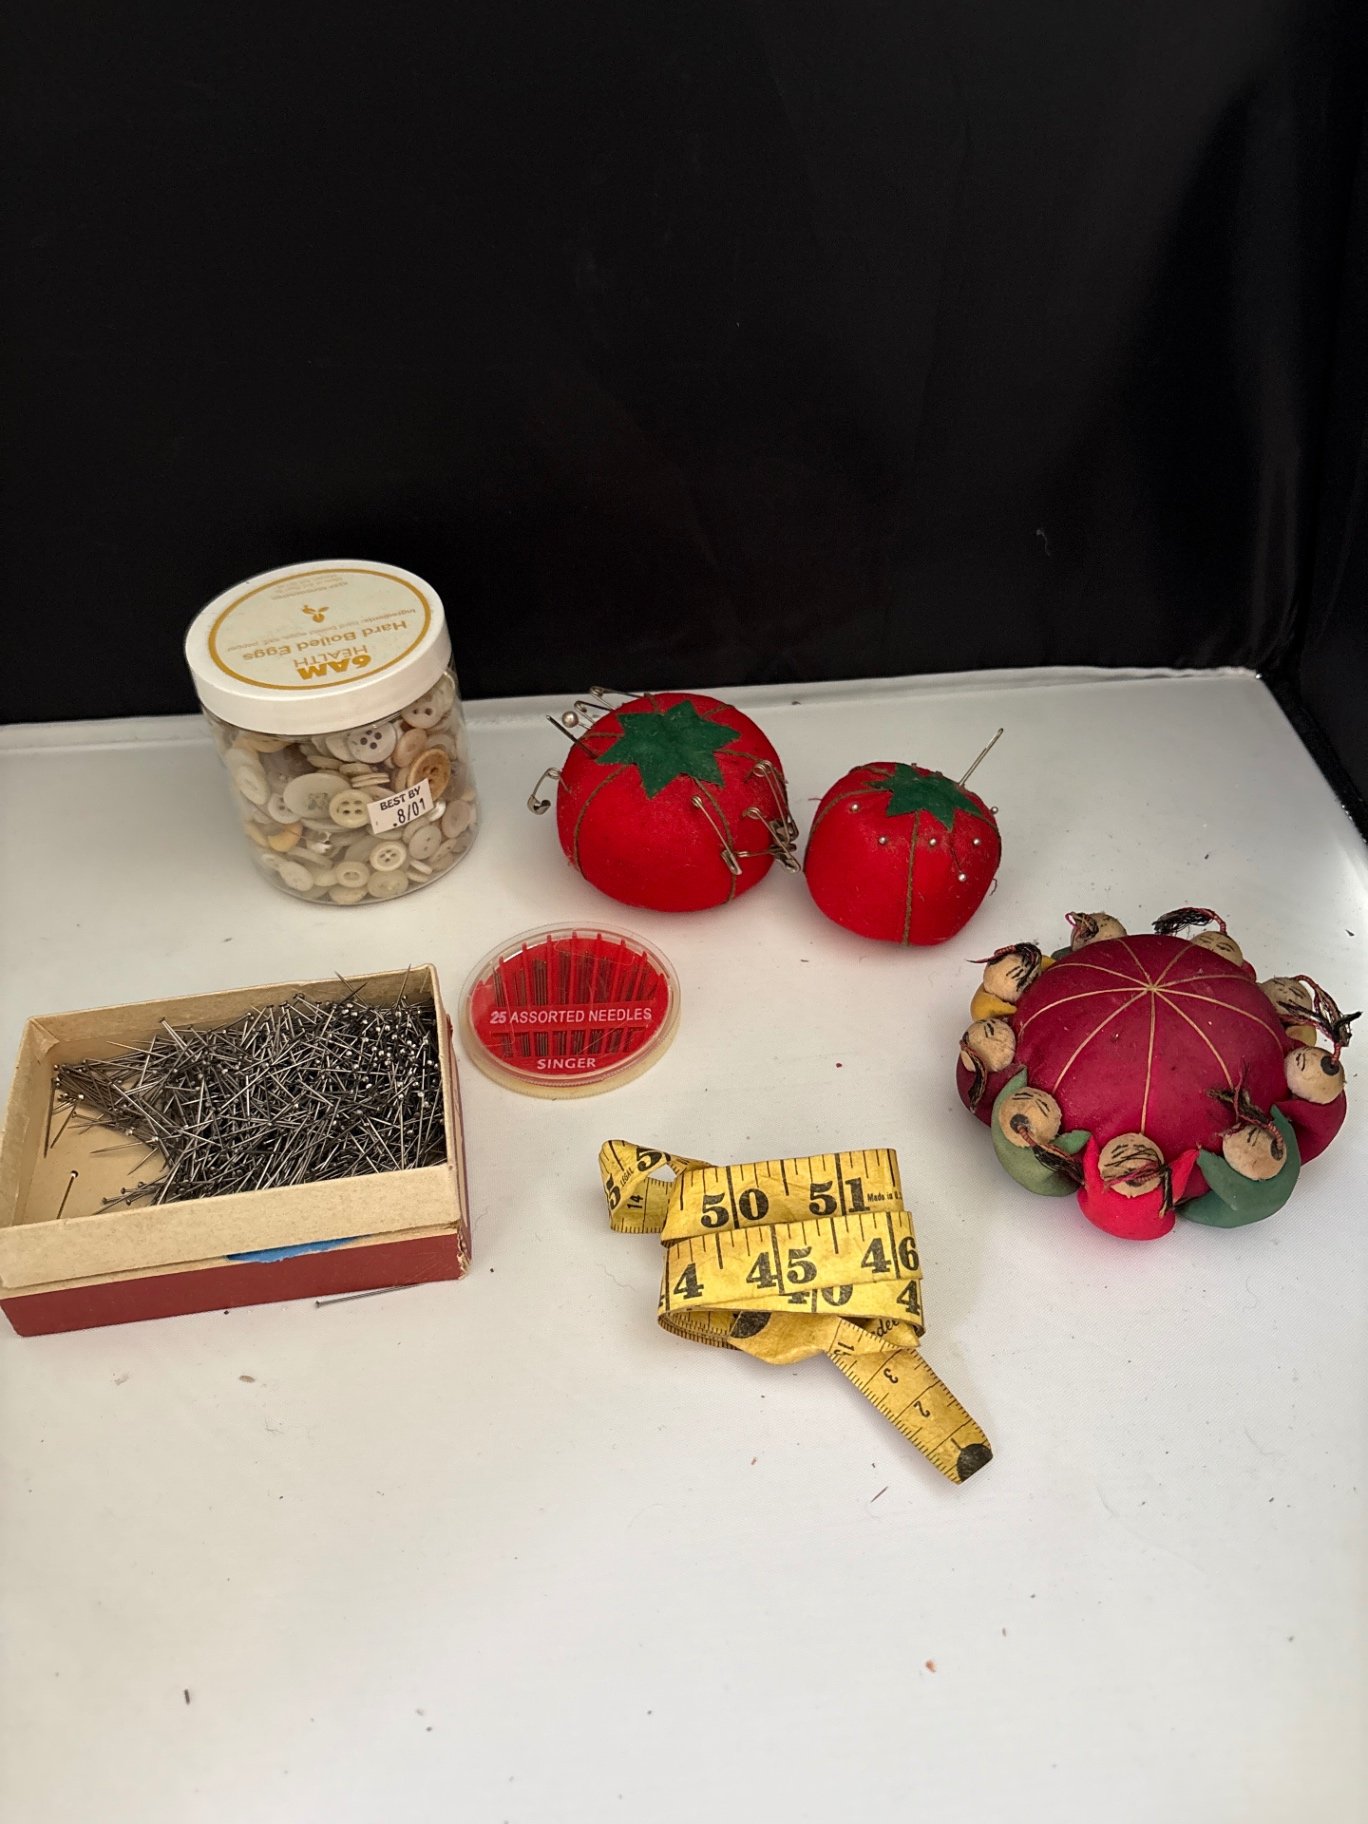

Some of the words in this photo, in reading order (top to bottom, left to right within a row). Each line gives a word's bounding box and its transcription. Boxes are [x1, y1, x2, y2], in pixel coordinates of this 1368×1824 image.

[361, 620, 407, 637] Hard
[296, 631, 356, 651] Boiled
[242, 645, 291, 662] Eggs
[292, 645, 369, 668] HEALTH
[296, 654, 372, 680] 6AM
[379, 793, 407, 811] BEST
[407, 785, 421, 799] BY
[490, 1010, 506, 1025] 25
[509, 1009, 584, 1024] ASSORTED
[588, 1007, 653, 1022] NEEDLES
[537, 1057, 597, 1070] SINGER
[620, 1167, 634, 1187] LEGAL
[627, 1194, 644, 1209] 14
[809, 1177, 870, 1217] 51
[867, 1191, 885, 1203] Made
[886, 1191, 893, 1200] in
[701, 1188, 769, 1228] 50
[860, 1236, 919, 1275] 46
[745, 1245, 817, 1294] 45
[883, 1368, 899, 1384] 3
[913, 1401, 930, 1418] 2
